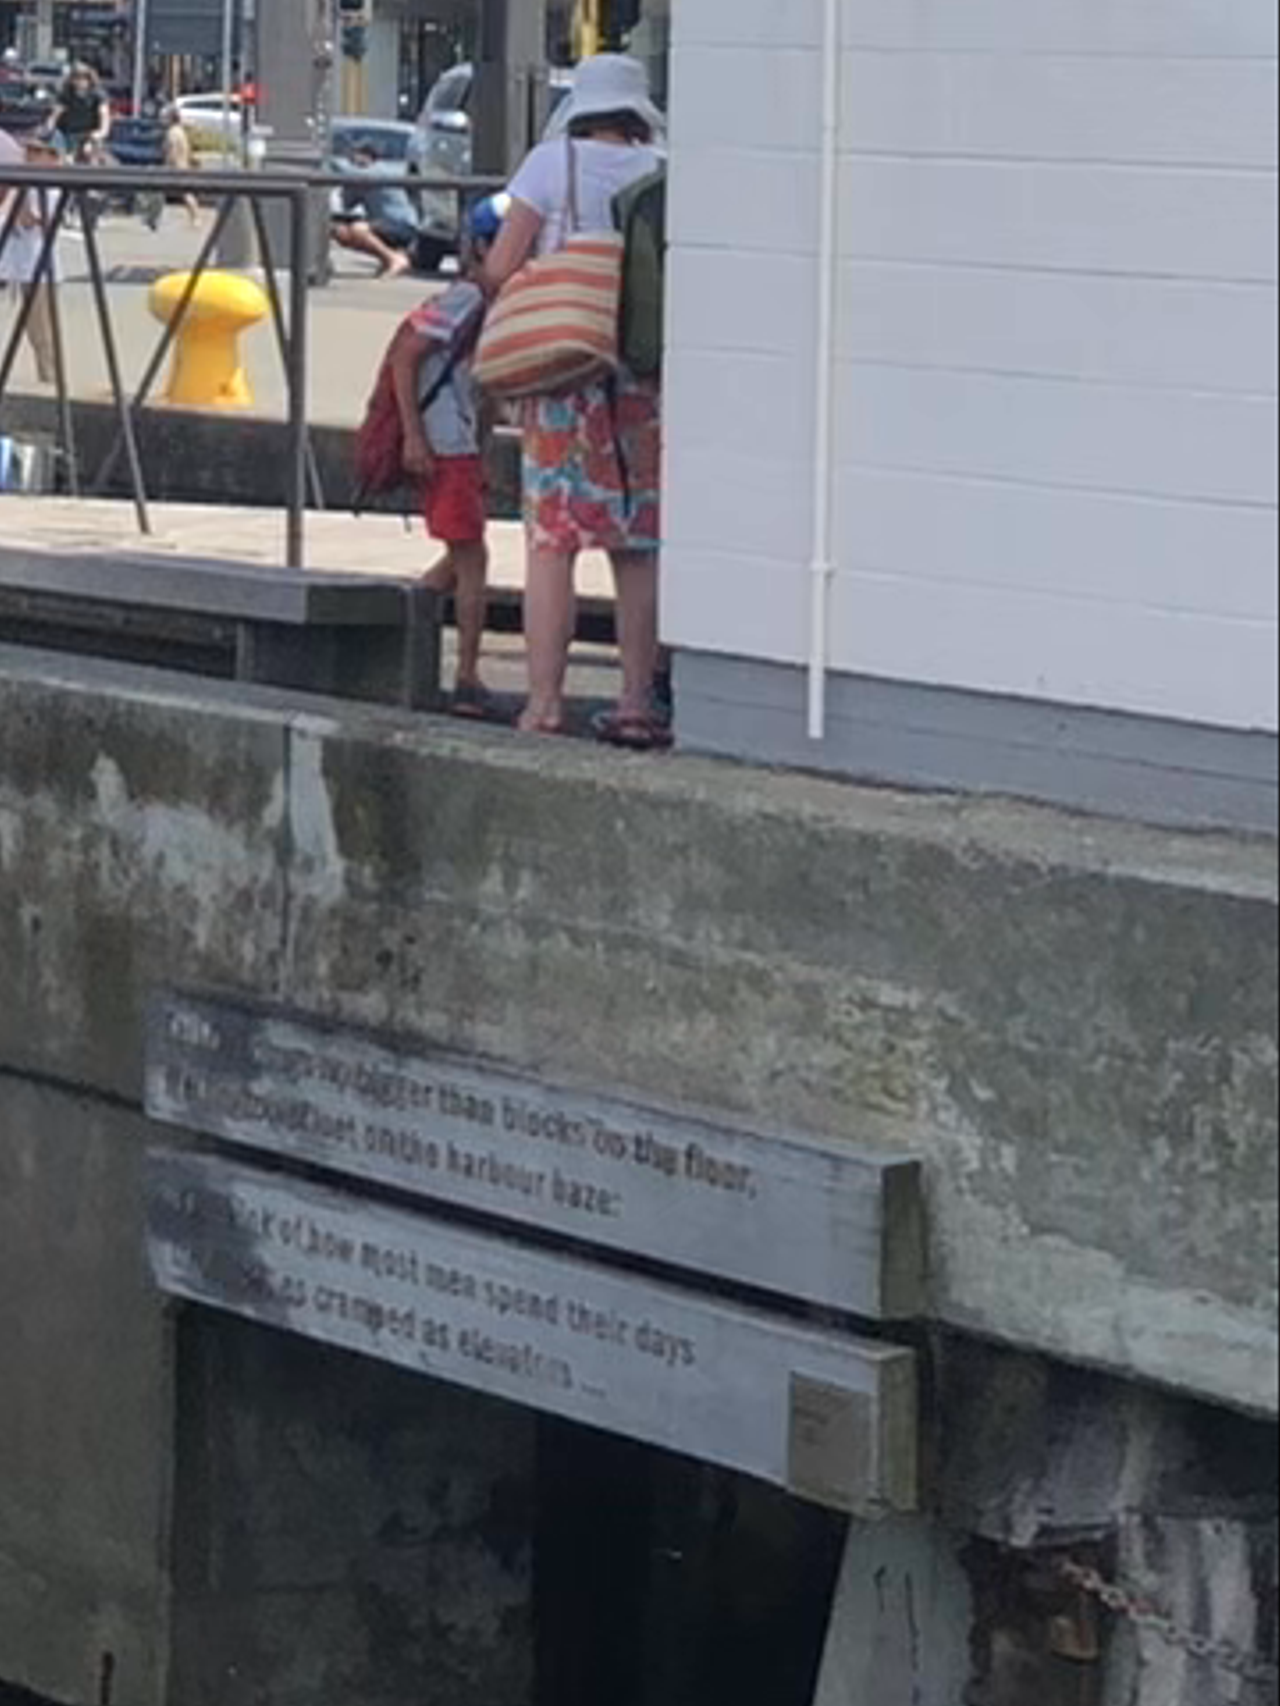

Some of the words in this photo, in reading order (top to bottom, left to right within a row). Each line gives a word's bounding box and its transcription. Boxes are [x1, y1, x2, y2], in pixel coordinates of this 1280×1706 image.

[397, 1128, 439, 1170] the
[445, 1140, 545, 1196] harbour
[440, 1085, 495, 1126] than
[501, 1094, 587, 1146] blocks
[633, 1130, 678, 1178] the
[312, 1283, 416, 1341] cramped
[421, 1318, 451, 1352] as
[360, 1241, 419, 1285] most
[425, 1262, 477, 1298] men
[484, 1280, 560, 1326] spend
[565, 1298, 628, 1346] their
[634, 1320, 697, 1368] days
